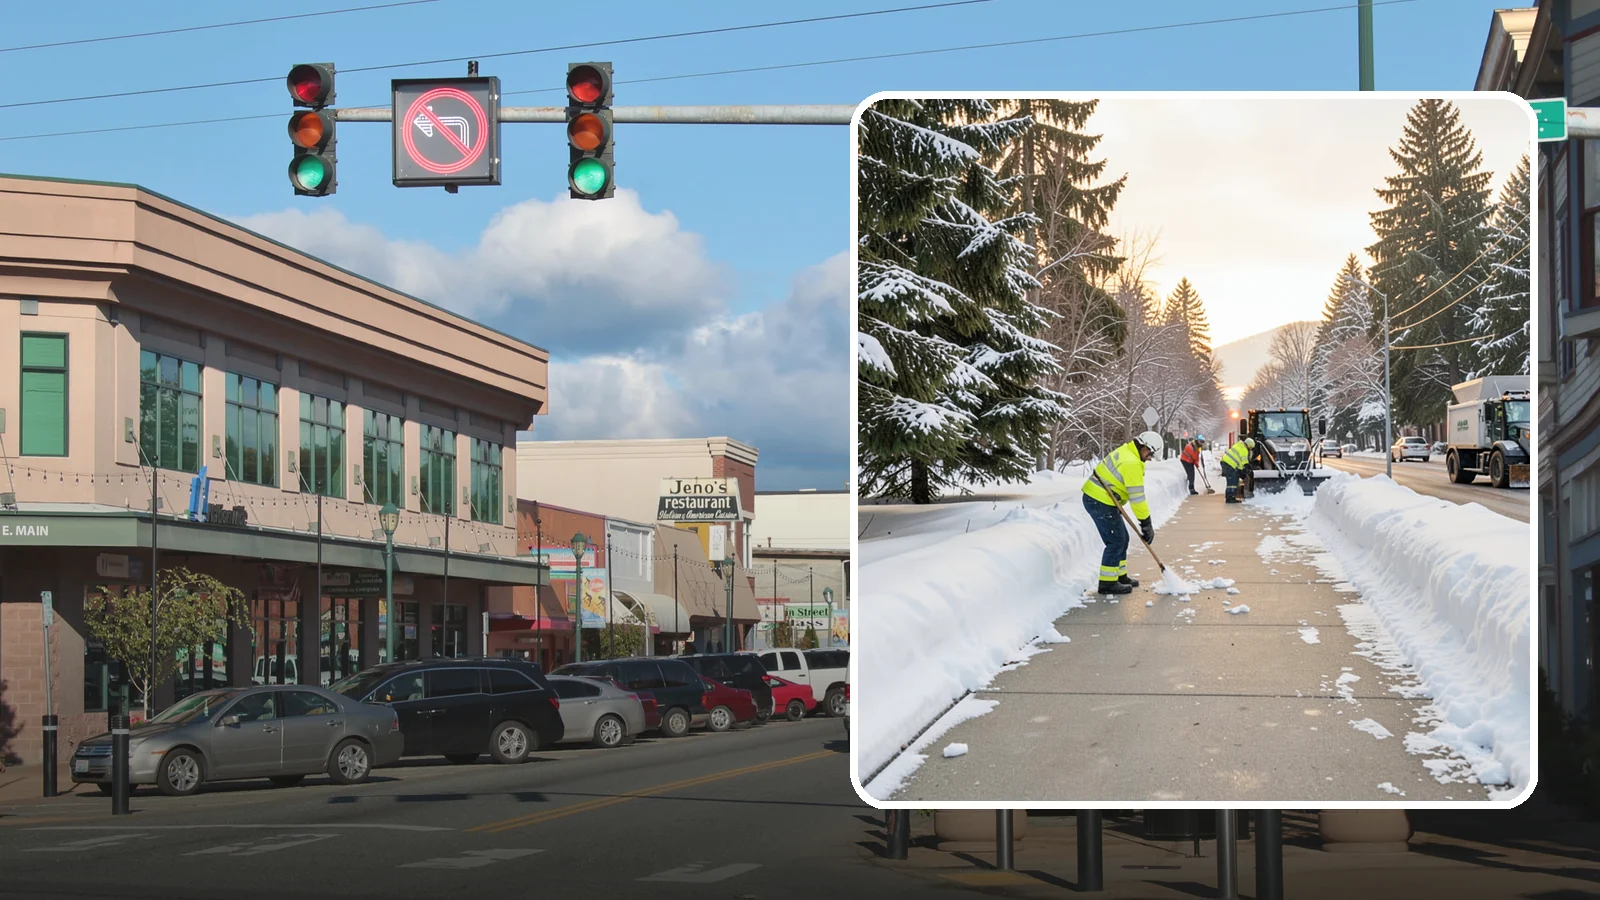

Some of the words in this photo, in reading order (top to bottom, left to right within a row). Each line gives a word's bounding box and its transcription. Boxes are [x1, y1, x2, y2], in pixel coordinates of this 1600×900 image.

[669, 479, 727, 494] Jeno's
[665, 496, 731, 509] restaurant
[658, 509, 682, 520] Italian
[686, 509, 714, 519] American
[715, 509, 738, 519] Cuisine
[2, 525, 13, 536] E.
[15, 525, 49, 536] MAIN
[797, 607, 829, 617] Street
